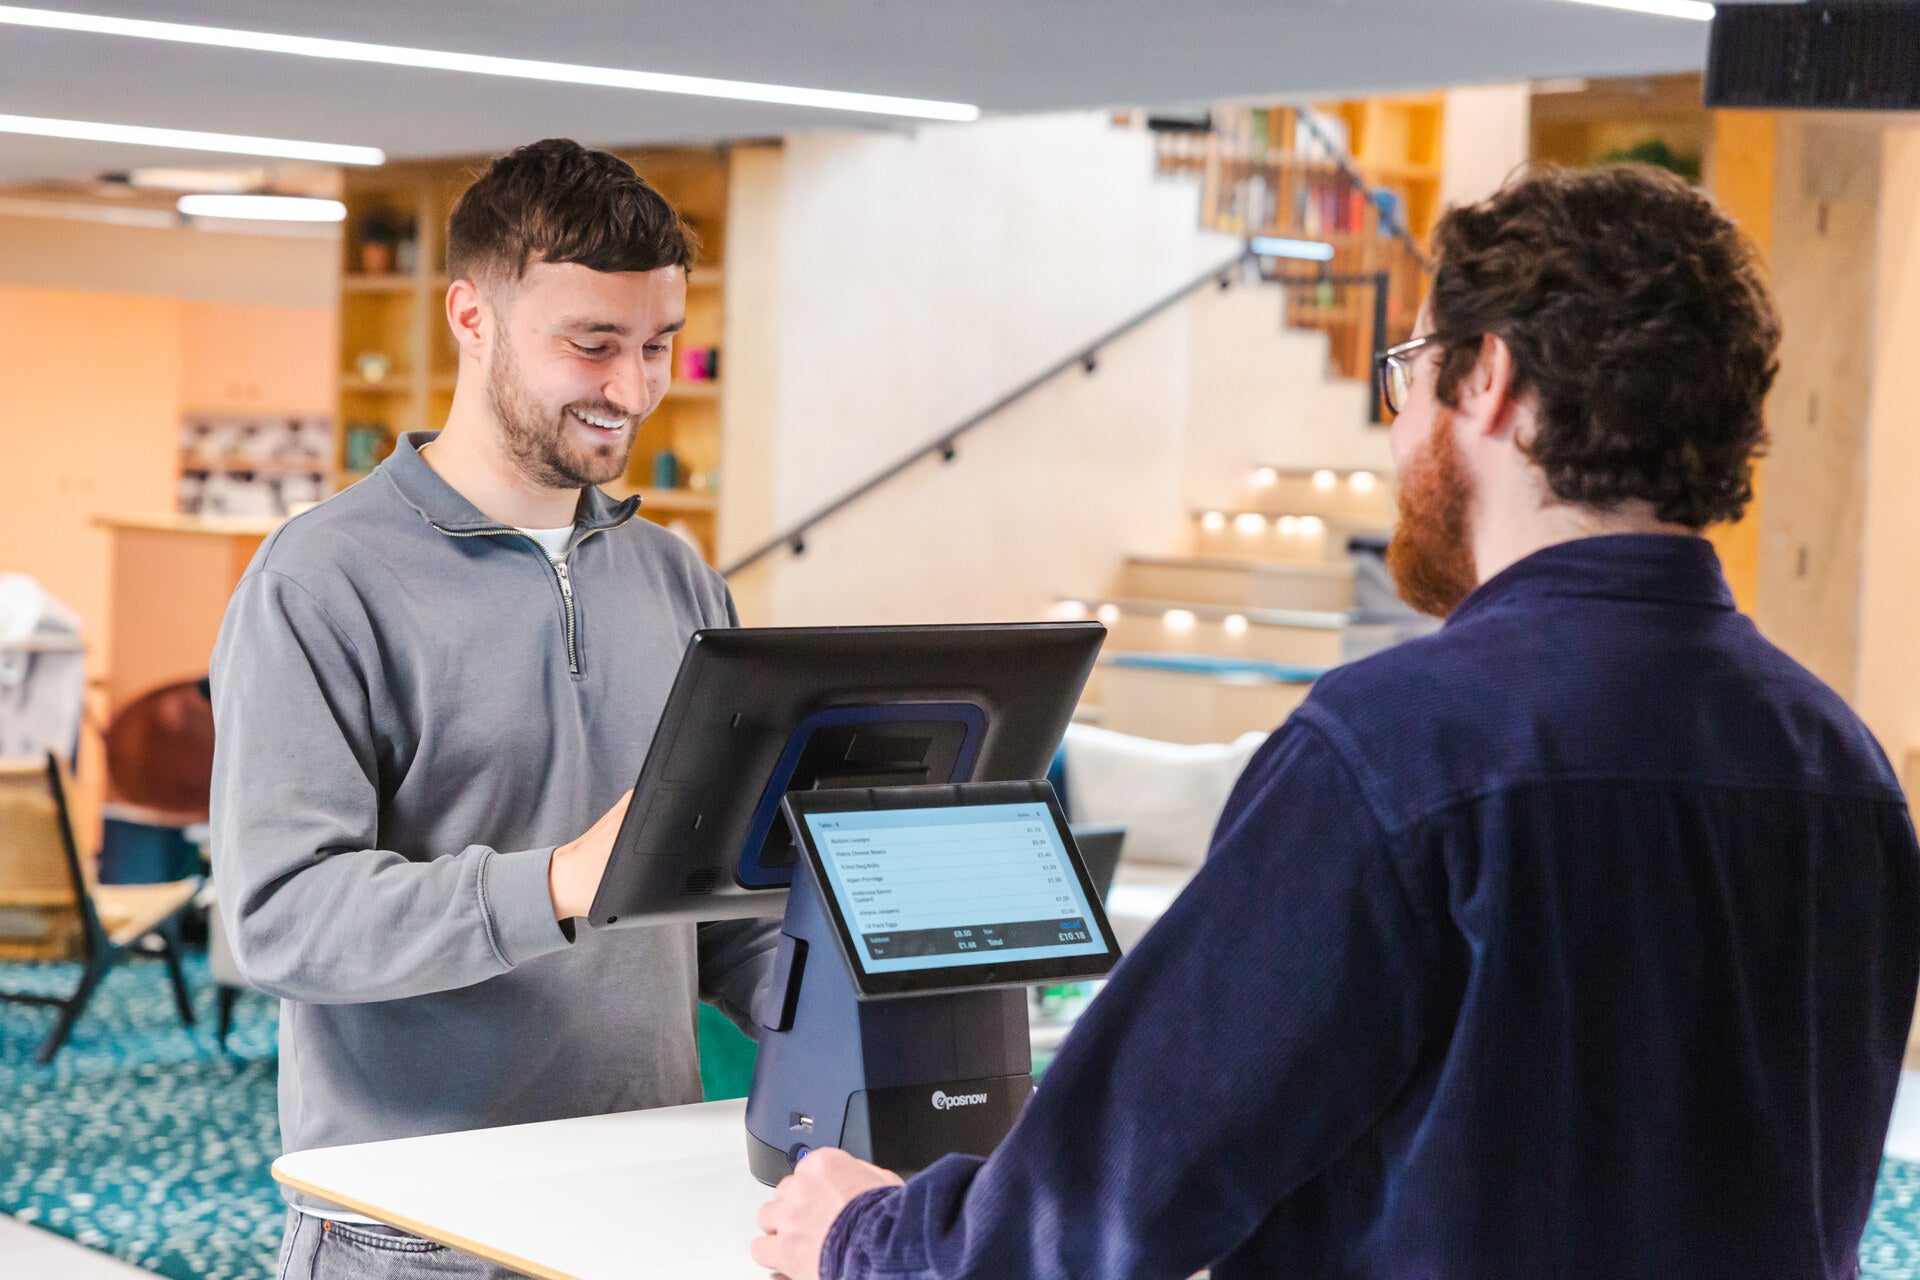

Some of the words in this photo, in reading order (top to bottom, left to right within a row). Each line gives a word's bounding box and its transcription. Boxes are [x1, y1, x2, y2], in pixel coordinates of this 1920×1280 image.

[1058, 931, 1086, 941] £10.18
[987, 938, 1004, 946] Total
[931, 1090, 988, 1110] eposnow
